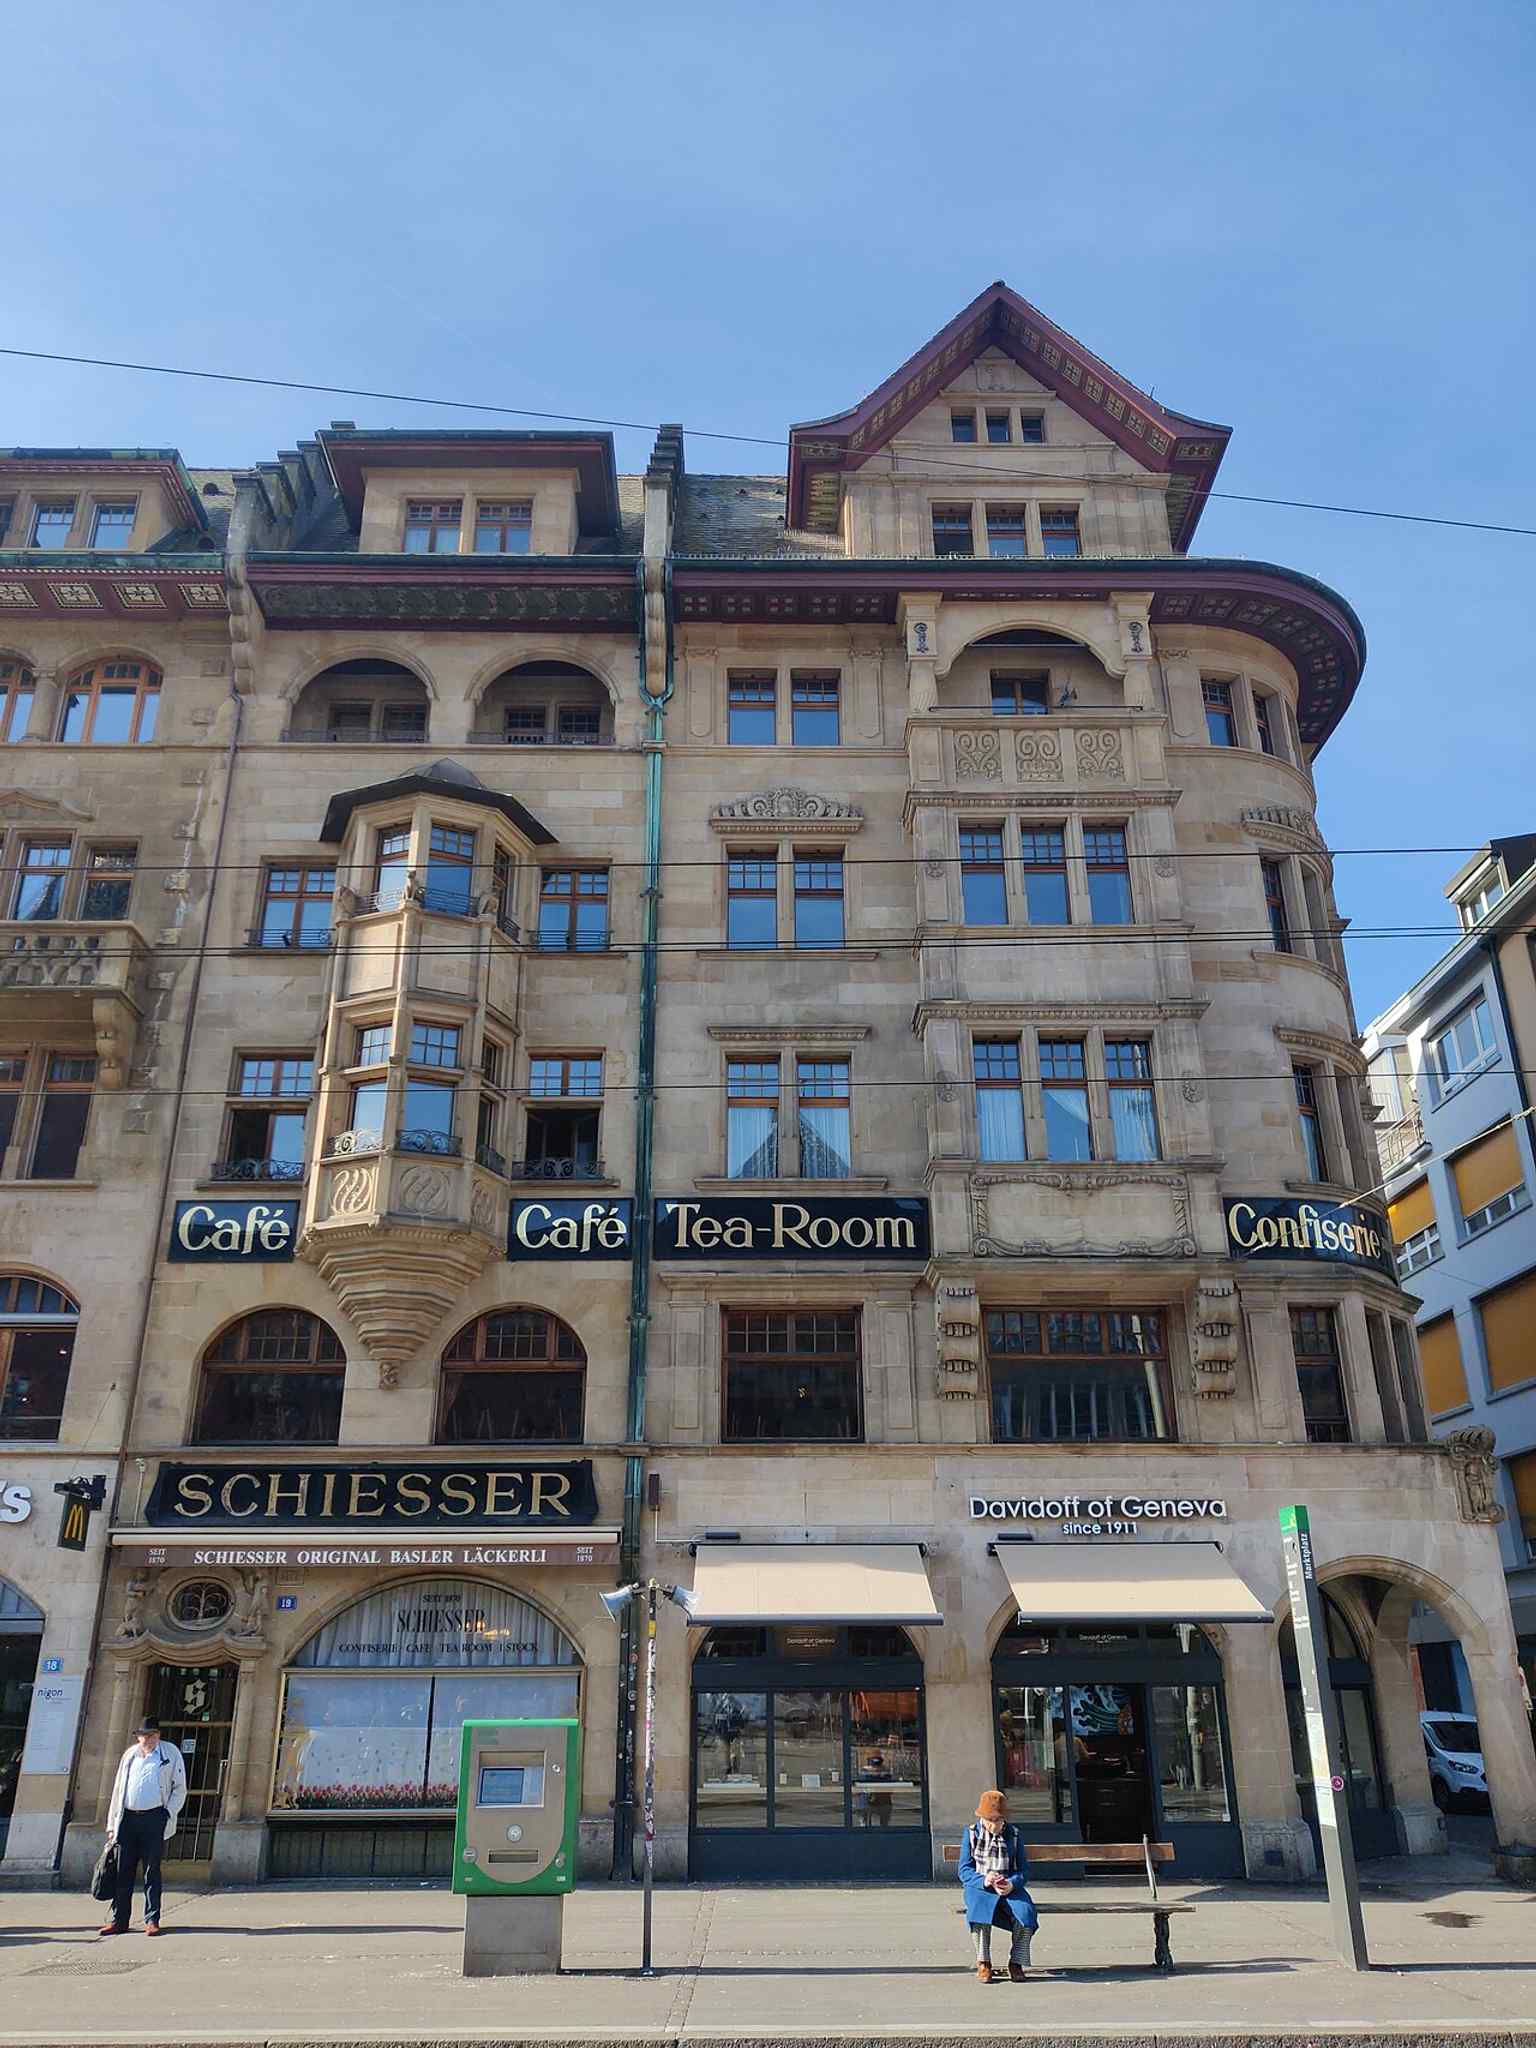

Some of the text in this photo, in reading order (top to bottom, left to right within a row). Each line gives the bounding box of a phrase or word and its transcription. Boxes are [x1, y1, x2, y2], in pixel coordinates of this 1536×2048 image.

[178, 1206, 291, 1255] Café
[516, 1204, 628, 1253] Café
[665, 1203, 916, 1249] Tea-Room
[1228, 1202, 1382, 1259] Confiserie
[173, 1472, 572, 1518] SCHIESSER
[969, 1496, 1227, 1519] Davidoff of Geneva
[1063, 1522, 1138, 1535] since 1911
[149, 1548, 167, 1556] SEIT
[194, 1547, 548, 1565] SCHIESSER ORIGINAL BASLER LÄCKERLI
[1301, 1533, 1313, 1580] Marktplatz
[397, 1608, 486, 1634] SCHIESSER
[46, 1660, 58, 1671] 18
